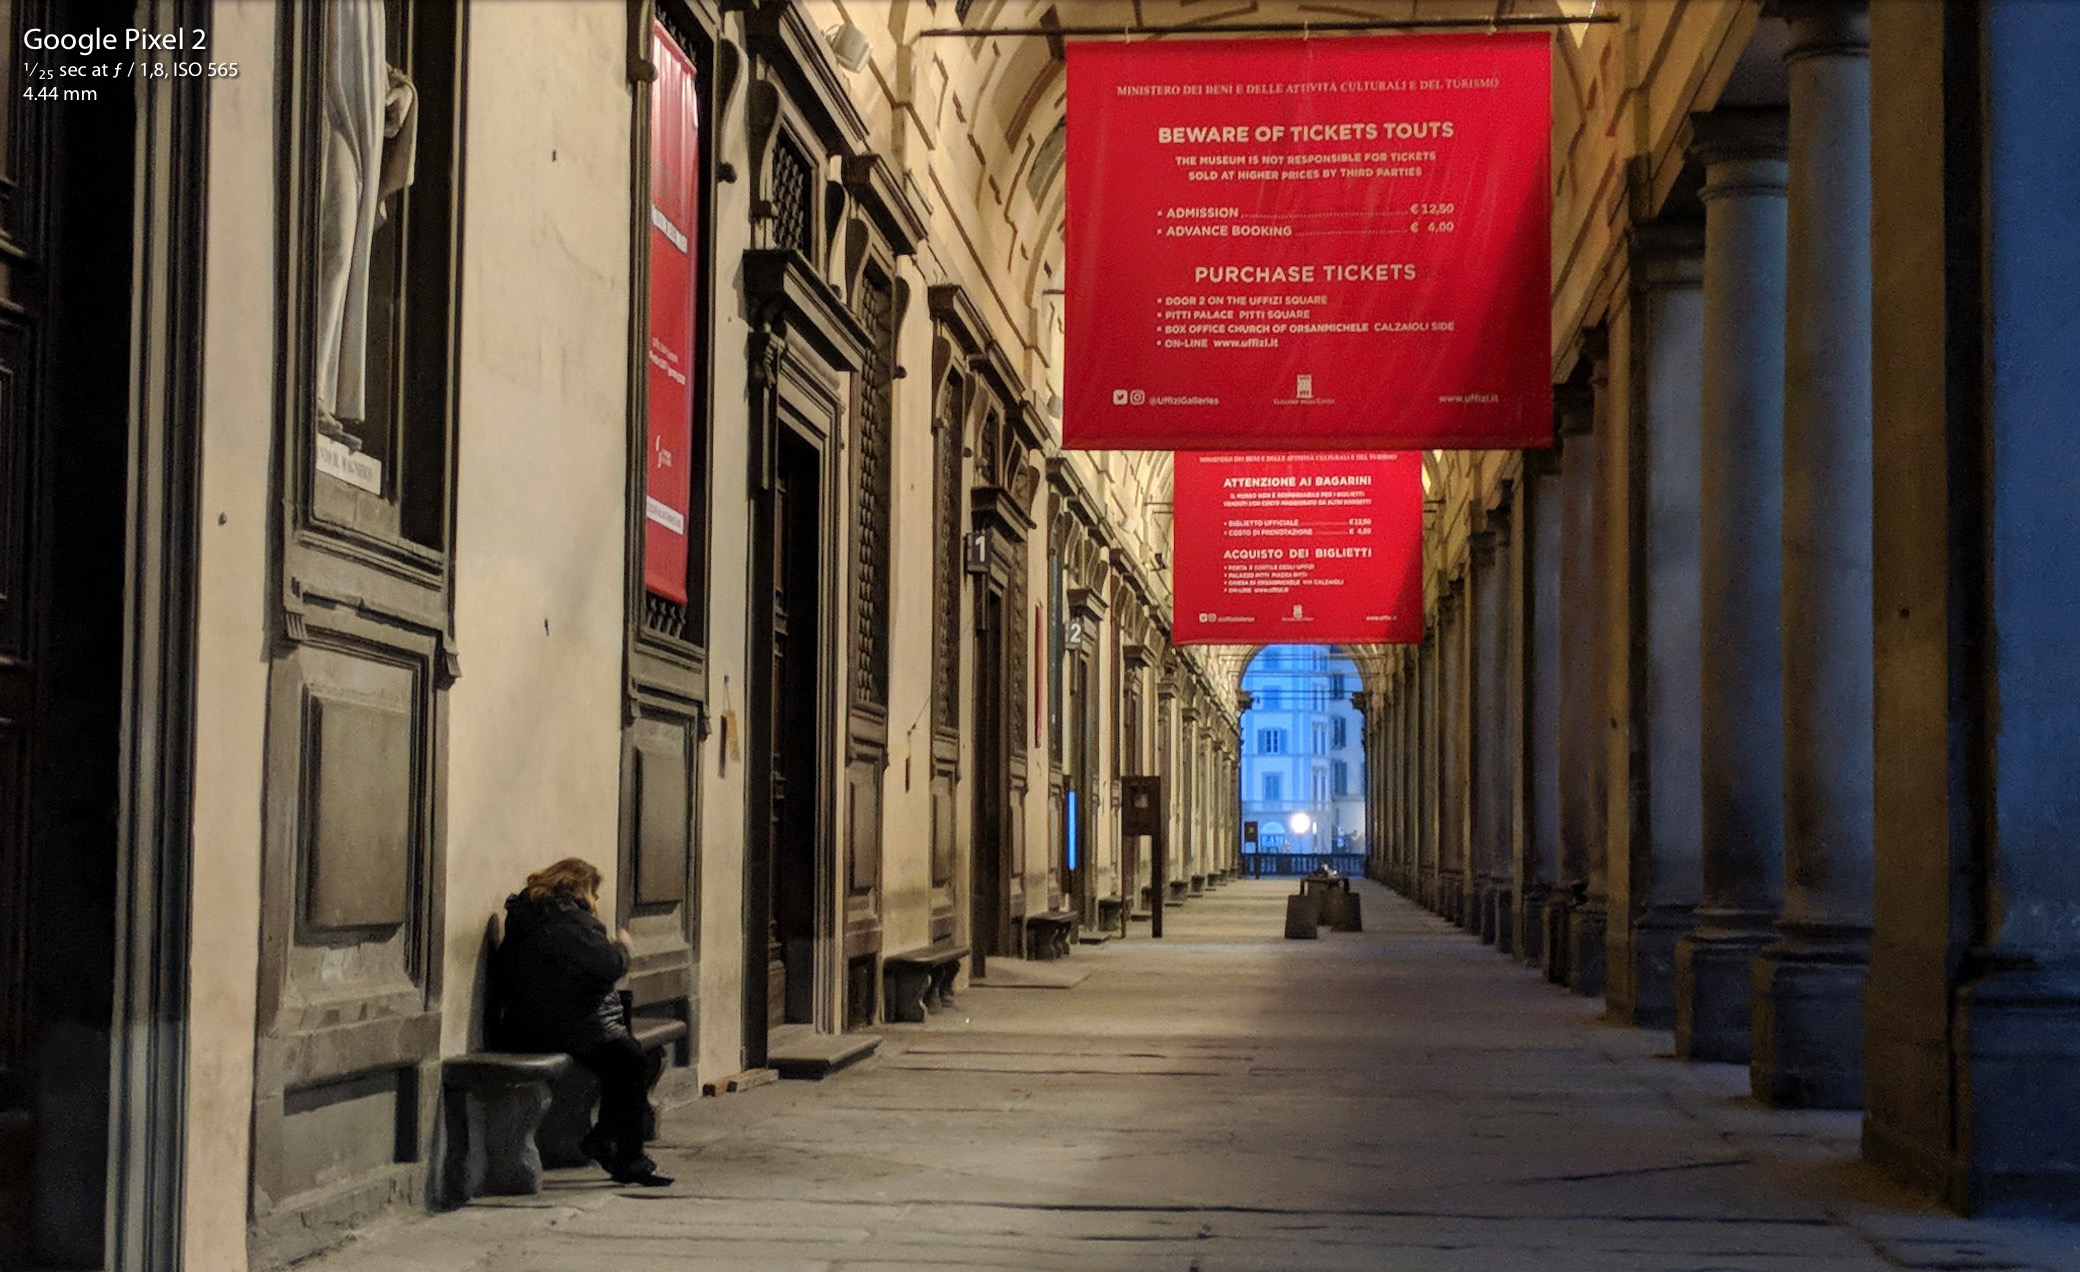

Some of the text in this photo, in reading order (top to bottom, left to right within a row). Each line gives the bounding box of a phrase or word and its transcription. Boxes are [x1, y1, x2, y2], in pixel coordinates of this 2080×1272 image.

[1117, 85, 1180, 96] MINISTERO
[1183, 84, 1202, 96] DEI
[1205, 84, 1232, 95] BENI
[1236, 84, 1243, 95] E
[1246, 83, 1283, 94] DELLE
[1340, 80, 1406, 92] CULTURALI
[1420, 80, 1441, 90] DEL
[1445, 78, 1499, 89] TURISMO
[1158, 121, 1454, 143] BEWARE OF TICKETS TOUTS
[1175, 151, 1436, 165] THE MUSEUM IS NOT RESPONSIBLE FOR TICKETS
[1188, 166, 1422, 180] SOLD AT HIGHER PRICES BY THIRD PARTIES
[1166, 203, 1454, 218] ADMISSION € 12,50
[1166, 222, 1454, 236] ADVANCE BOOKING € 4,00
[1195, 264, 1416, 283] PURCHASE TICKETS
[1165, 296, 1328, 306] DOOR 2 ON THE UFFIZI SQUARE
[1165, 310, 1310, 320] PITTI PALACE PITTI SQUARE
[1165, 322, 1455, 334] BOX OFFICE CHURCH OF ORSANMICHELE CALZAIOLI SIDE
[1164, 338, 1279, 348] ON-LINE www.uffizi.it
[1223, 476, 1372, 488] ATTENZIONE AI BAGARINI
[1264, 518, 1299, 526] UFFICIALE
[1261, 528, 1313, 536] PRENOTAZIONE
[975, 536, 986, 562] 1
[1223, 548, 1372, 559] ACQUISTO DEI BIGLIETTI
[1070, 622, 1081, 643] 2
